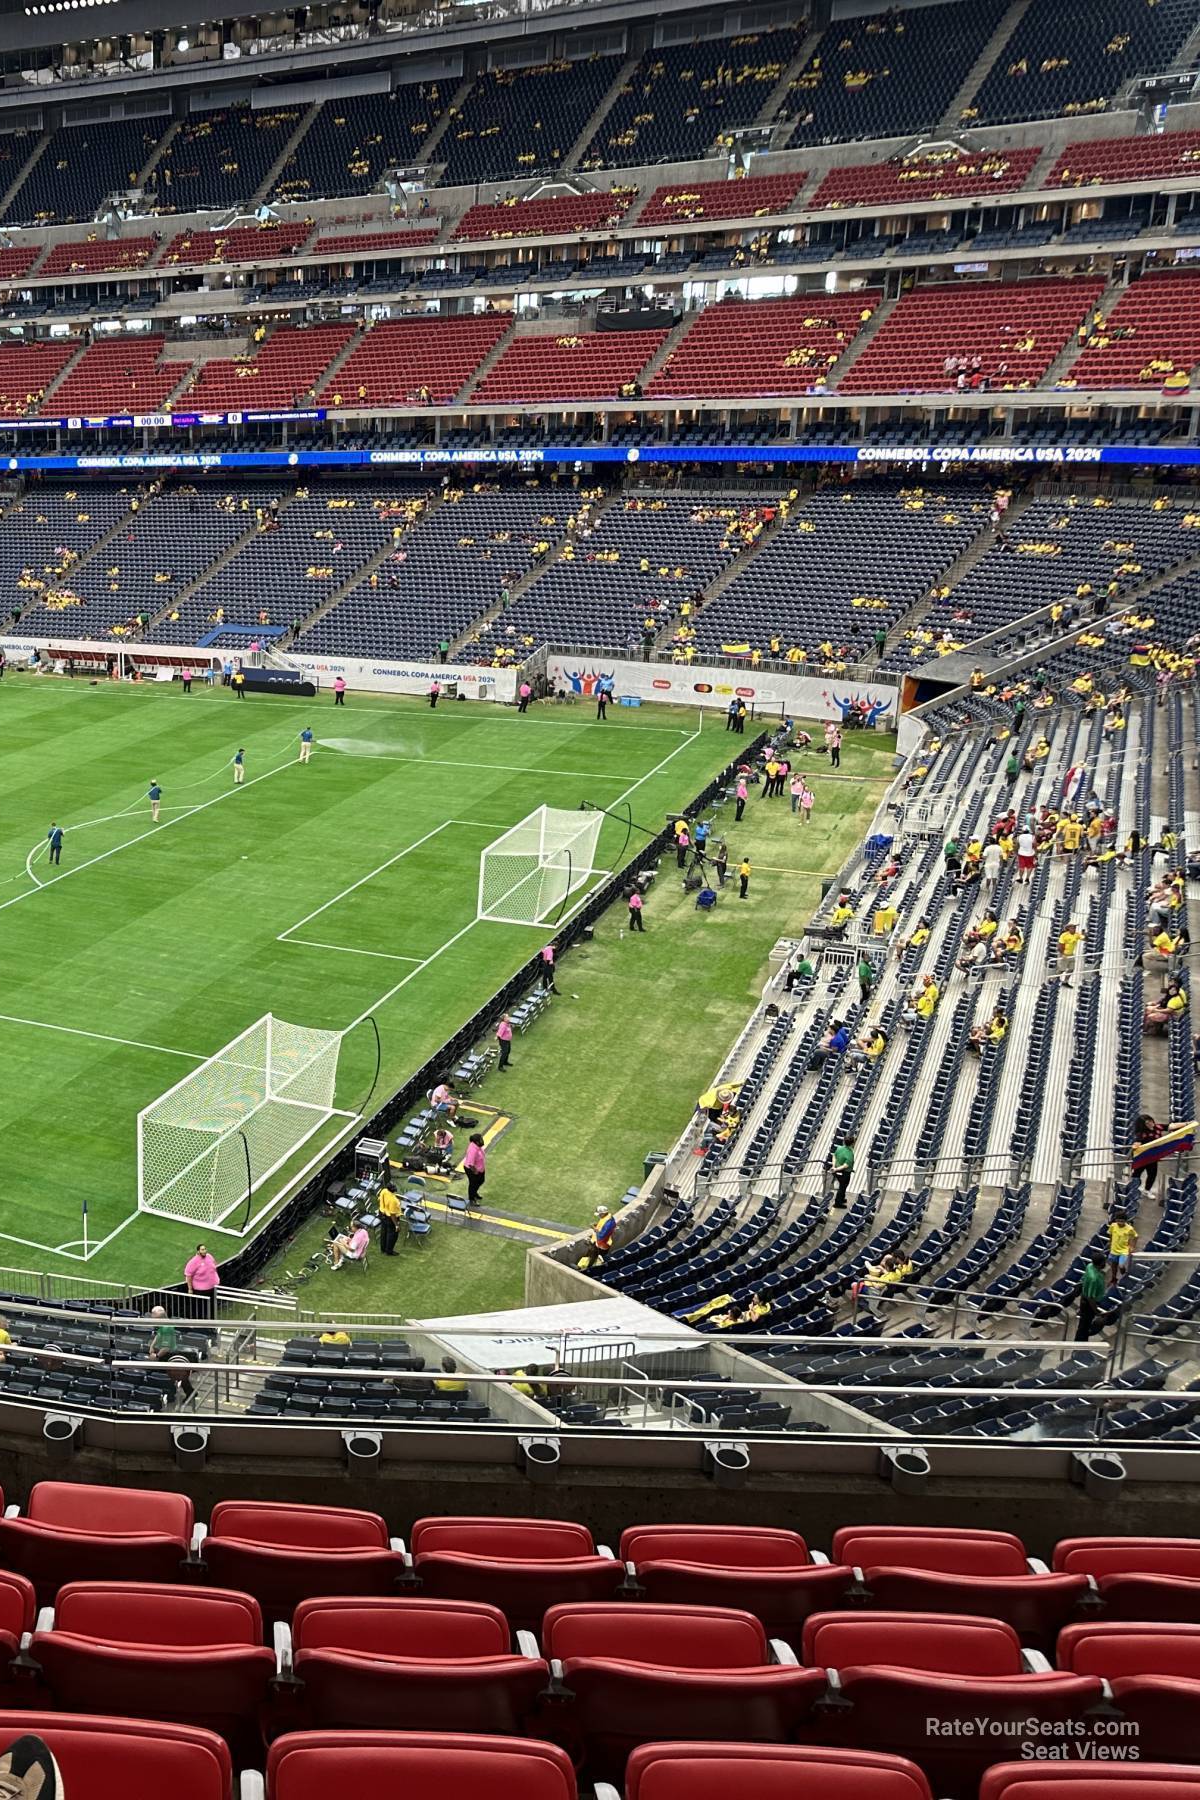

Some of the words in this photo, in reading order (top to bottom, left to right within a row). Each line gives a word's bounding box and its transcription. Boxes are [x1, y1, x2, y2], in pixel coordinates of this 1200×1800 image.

[370, 451, 423, 462] CONMEBOL
[423, 451, 450, 461] COPA
[450, 451, 497, 461] AMERICA
[497, 450, 518, 461] USA
[518, 450, 545, 460] 2024
[857, 447, 931, 460] CONMEBOL
[932, 447, 969, 460] COPA
[969, 447, 1034, 461] AMERICA
[1035, 447, 1064, 461] USA
[1065, 447, 1103, 461] 2024
[77, 457, 121, 467] CONMEBOL
[122, 457, 144, 467] COPA
[144, 456, 183, 466] AMERICA
[182, 456, 200, 466] USA
[200, 455, 222, 465] 2024
[316, 663, 328, 672] USA
[329, 664, 345, 672] 2024
[372, 668, 410, 678] CONMEBOL
[411, 671, 429, 679] COPA
[430, 672, 462, 681] AMERICA
[463, 674, 477, 682] USA
[478, 675, 496, 683] 2024
